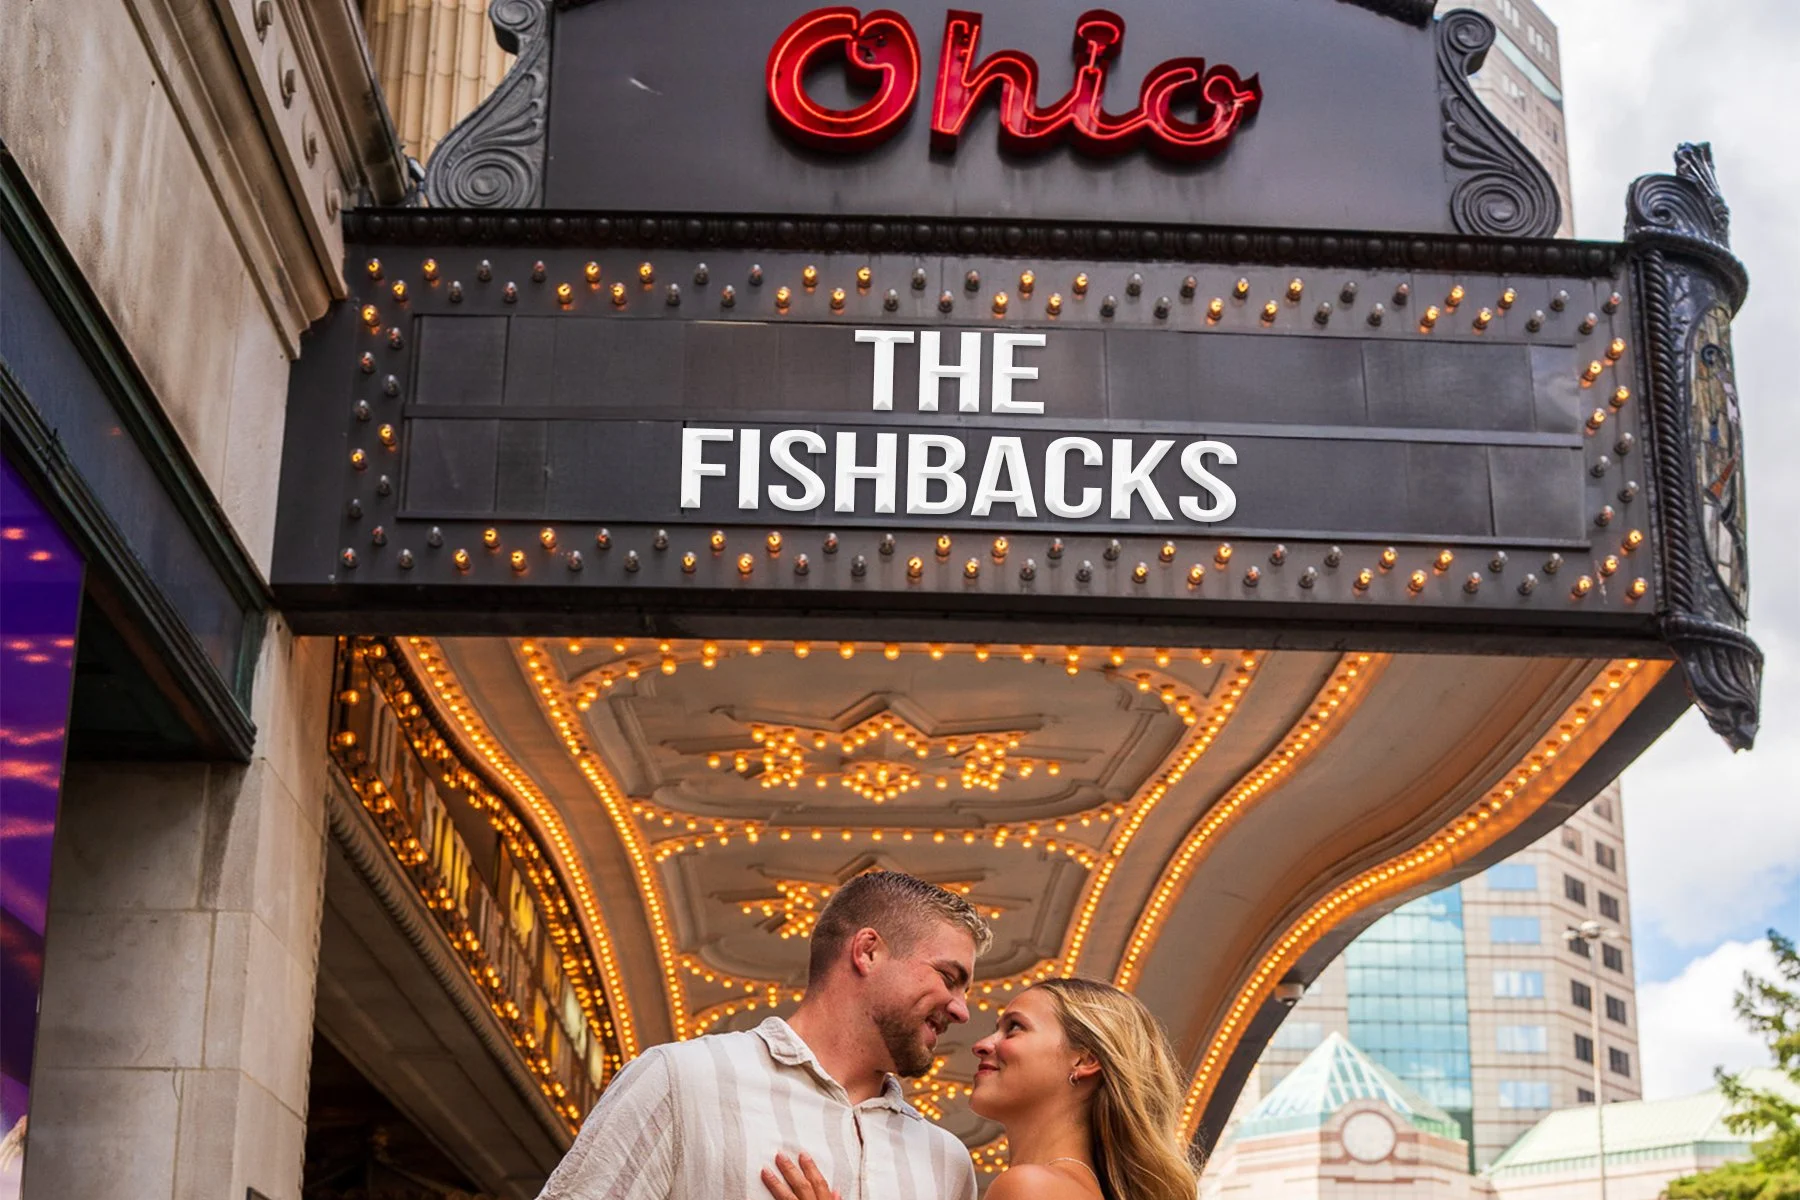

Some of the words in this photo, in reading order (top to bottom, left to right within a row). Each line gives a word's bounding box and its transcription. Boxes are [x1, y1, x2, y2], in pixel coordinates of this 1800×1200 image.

[766, 6, 1263, 158] Ohio
[855, 330, 1047, 414] THE
[680, 427, 1238, 523] FISHBACKS
